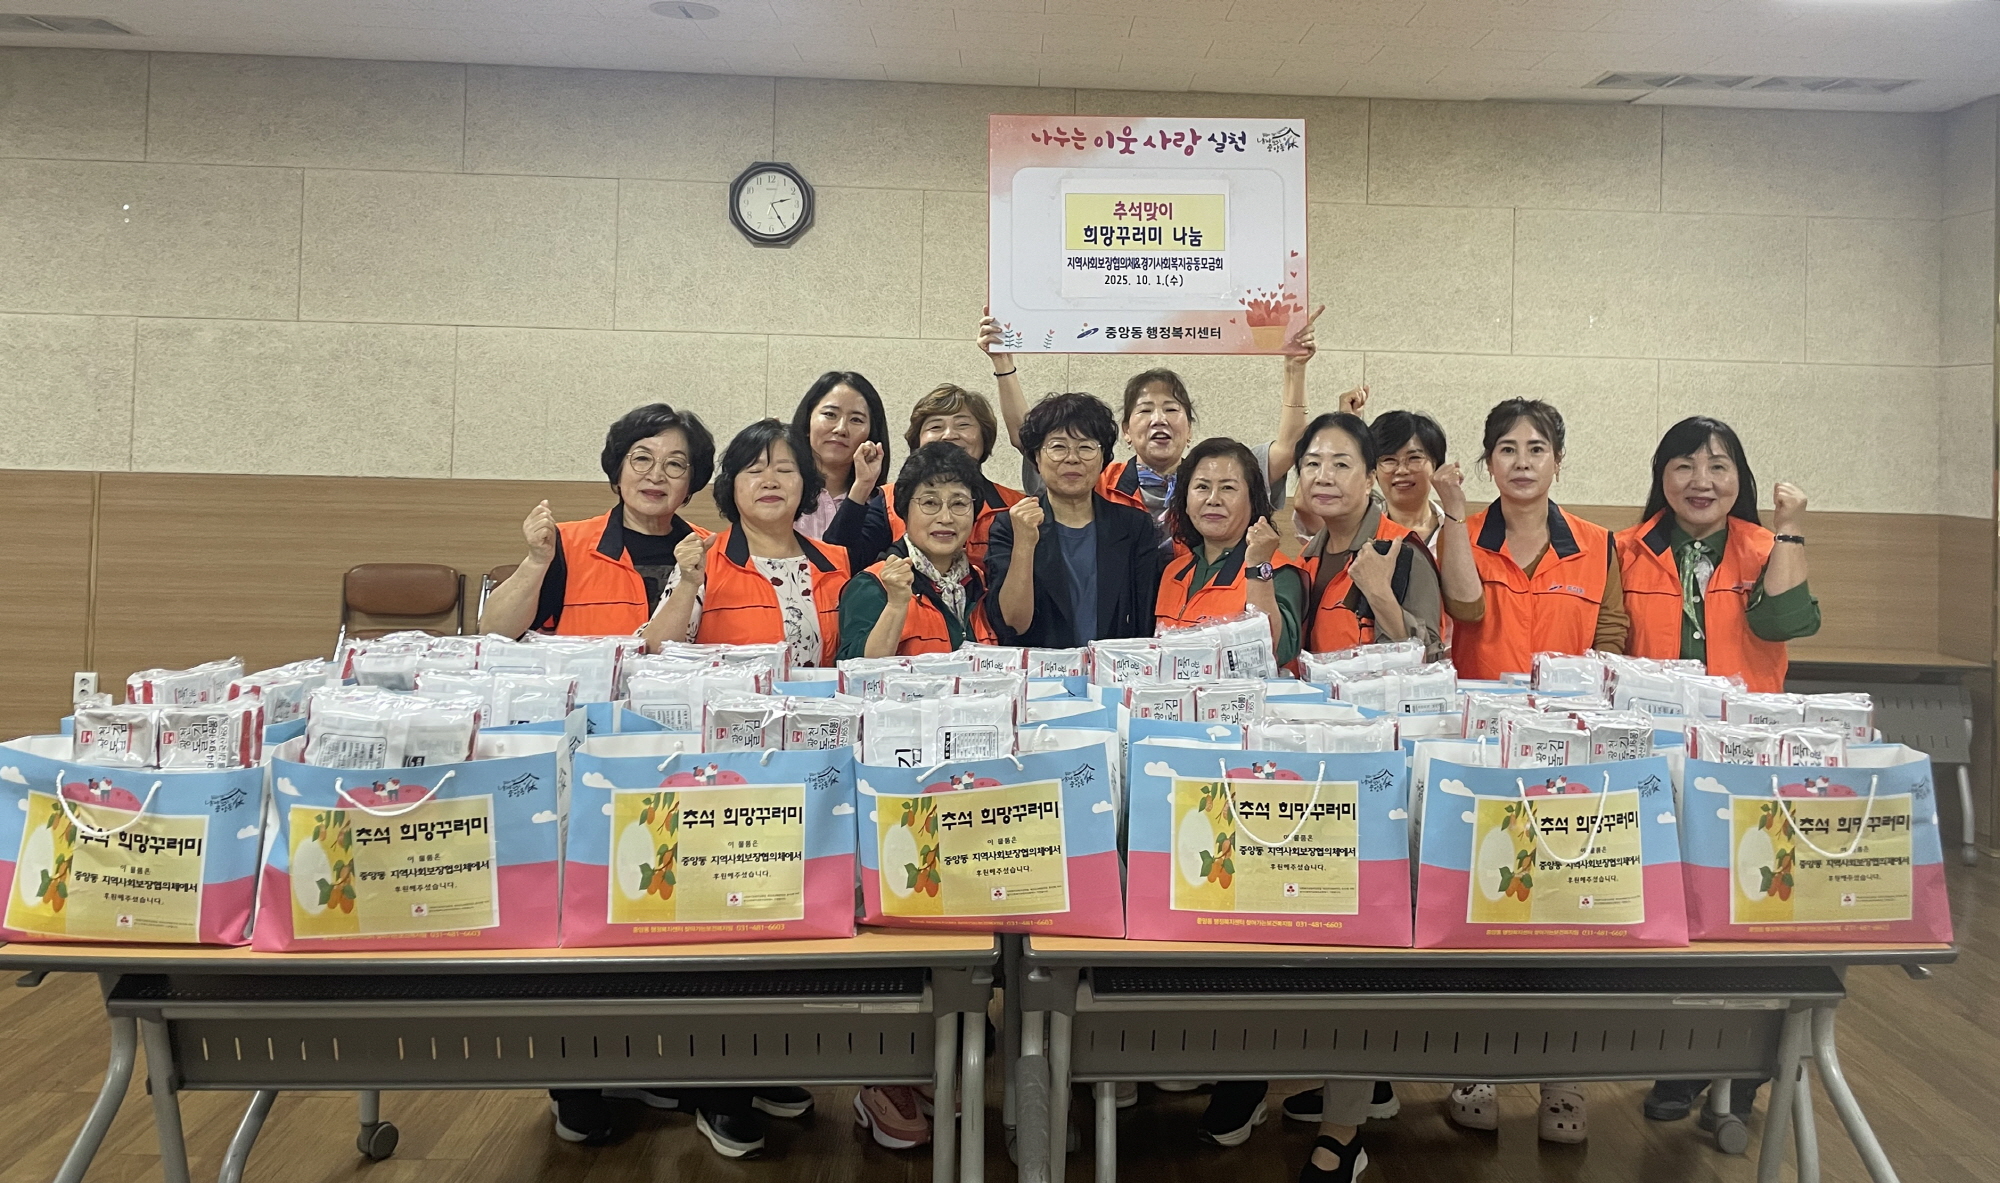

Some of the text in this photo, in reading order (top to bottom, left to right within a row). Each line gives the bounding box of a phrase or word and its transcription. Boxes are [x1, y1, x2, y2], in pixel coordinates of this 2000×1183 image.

[1031, 127, 1087, 150] 나누는
[1094, 126, 1138, 154] 이웃
[1143, 128, 1202, 156] 사랑
[1208, 131, 1247, 153] 실천
[768, 175, 776, 183] 12
[1113, 201, 1173, 221] 추석맞이
[769, 225, 774, 233] 6
[1084, 225, 1203, 247] 희망꾸러미 나눔
[1104, 275, 1131, 286] 2025.
[1136, 275, 1151, 286] 10.
[1105, 326, 1221, 339] 중앙동 행정복지센터
[1178, 657, 1190, 680] 돌김
[110, 724, 127, 754] 돌김
[192, 724, 208, 754] 돌김
[732, 724, 744, 744] 광천
[744, 720, 760, 748] 돌김
[808, 728, 818, 748] 광천
[1536, 743, 1547, 762] 광천
[1548, 740, 1564, 766] 돌김
[683, 806, 803, 828] 추석 희망꾸러미
[942, 801, 1059, 831] 추석 희망꾸러미
[1239, 801, 1270, 820] 추석
[356, 817, 488, 846] 추석 희망꾸러미
[1540, 816, 1569, 835] 추석
[1799, 817, 1830, 835] 추석
[118, 830, 203, 856] 희망꾸러미
[1239, 846, 1356, 857] 중앙동 지역사회보장협의체에서
[681, 851, 802, 866] 중앙동 지역사회보장협의체에서
[944, 845, 1061, 866] 중앙동 지역사회보장협의체에서
[359, 860, 490, 881] 중앙동 지역사회보장협의체에서
[713, 870, 772, 880] 후원해주셨습니다.
[976, 866, 1032, 877] 후원해주셨습니다.
[74, 871, 198, 893] 중앙동 지역사회보장협의체에서
[736, 924, 785, 932] 031-481-6603
[1296, 921, 1343, 929] 031-481-6603
